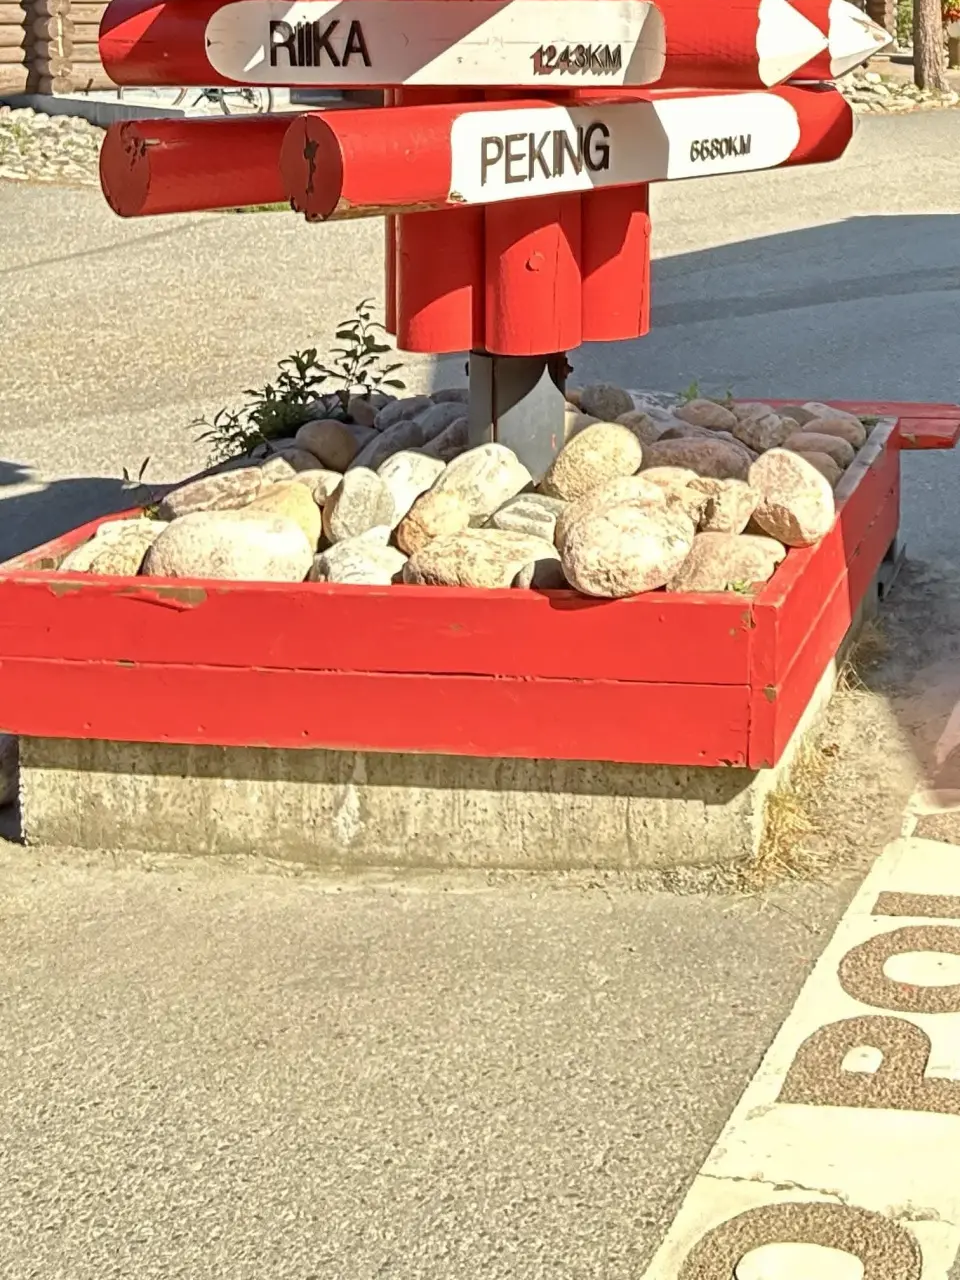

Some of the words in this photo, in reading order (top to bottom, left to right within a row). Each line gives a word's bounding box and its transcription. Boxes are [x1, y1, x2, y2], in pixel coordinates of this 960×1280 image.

[269, 20, 372, 67] RIIKA
[531, 44, 622, 70] 1243KM
[481, 122, 611, 187] PEKING
[690, 134, 751, 162] 6680KM
